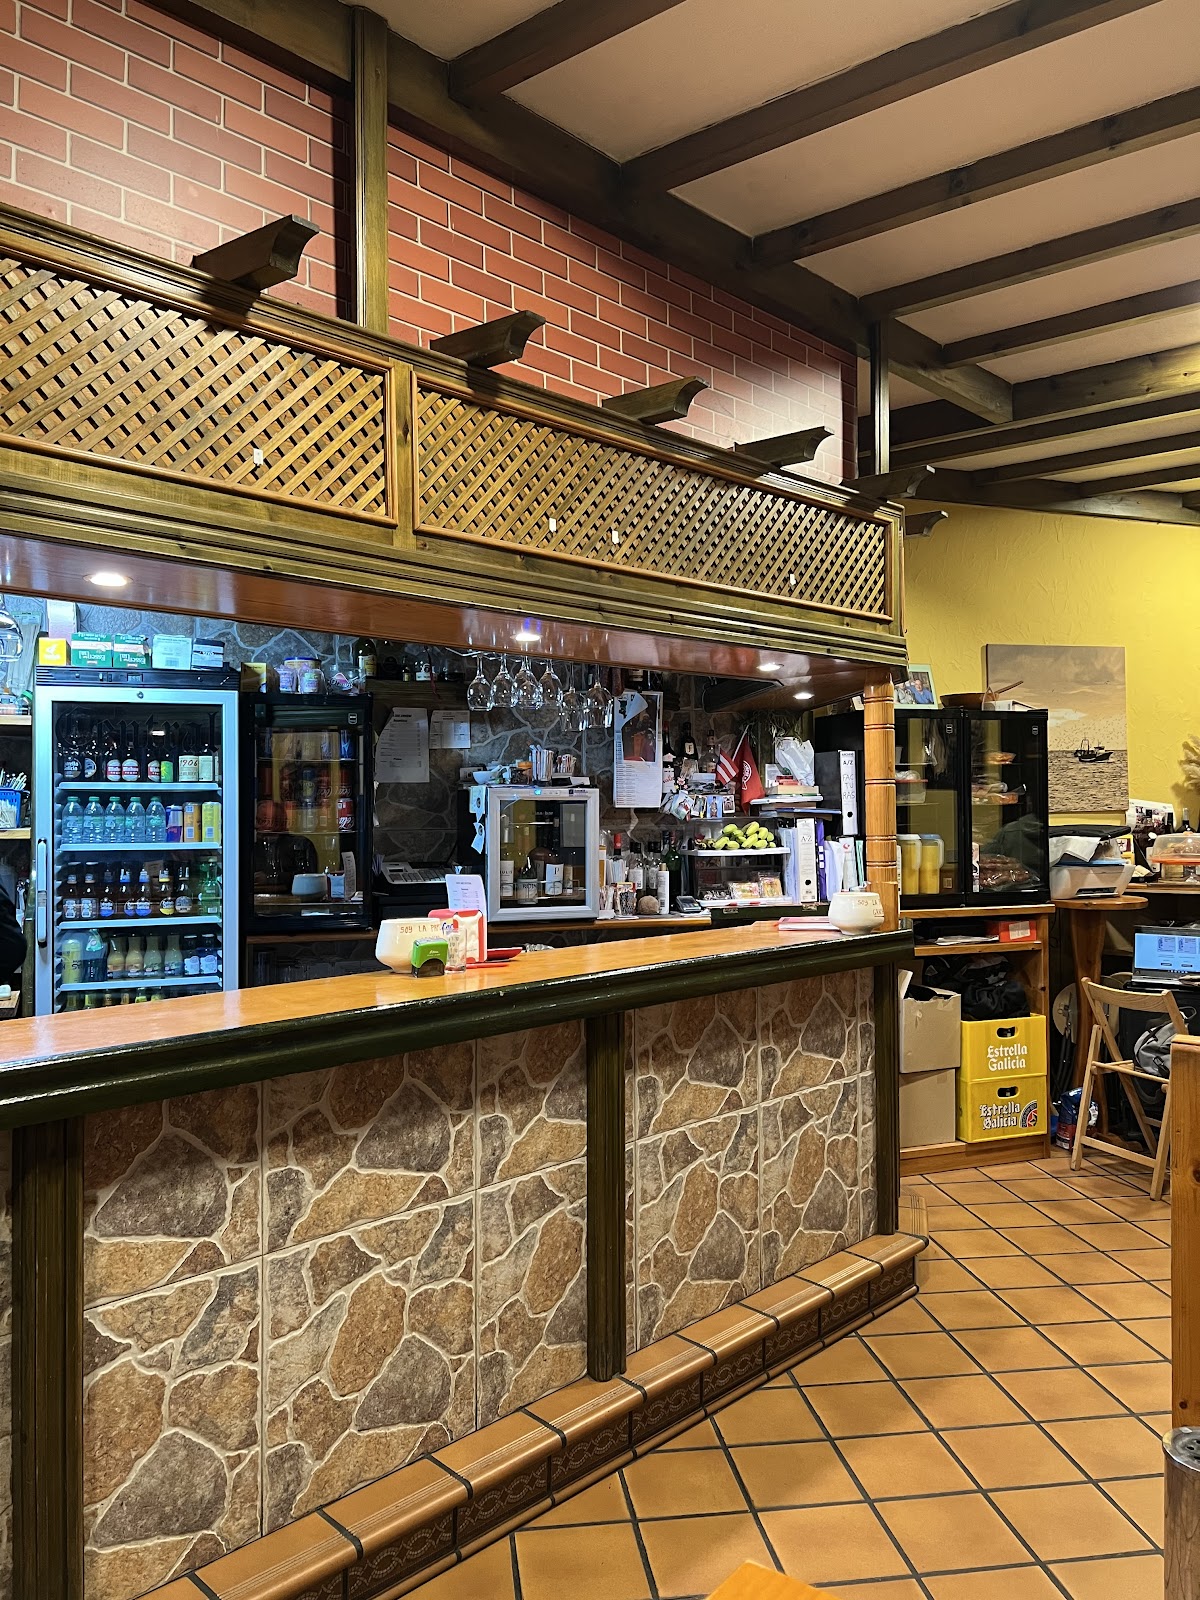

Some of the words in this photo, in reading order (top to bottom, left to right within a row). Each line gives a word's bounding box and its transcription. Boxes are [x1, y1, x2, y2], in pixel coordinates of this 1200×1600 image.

[55, 706, 219, 754] Central
[179, 759, 199, 768] 1906
[842, 791, 856, 800] RAS
[400, 926, 413, 934] SOY
[987, 1043, 1027, 1058] Estrella
[989, 1057, 1026, 1071] Galicia
[980, 1101, 1020, 1117] Estrella
[983, 1114, 1017, 1130] Galicia
